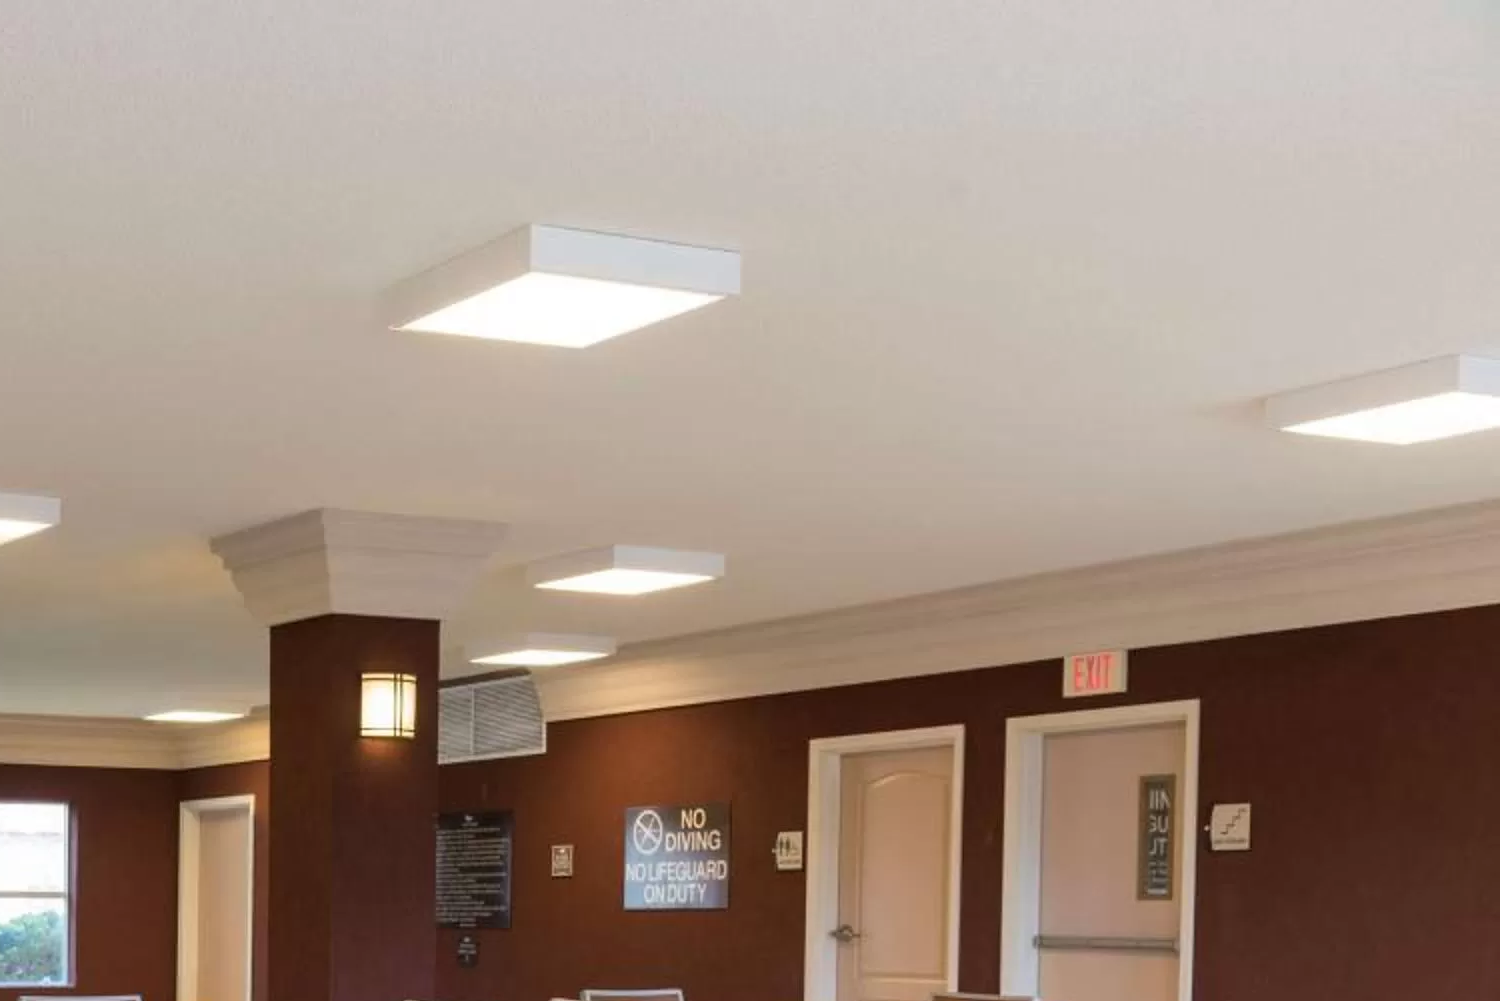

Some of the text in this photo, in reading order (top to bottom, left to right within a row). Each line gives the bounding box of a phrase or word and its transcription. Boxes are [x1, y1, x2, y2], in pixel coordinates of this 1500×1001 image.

[1073, 653, 1113, 692] EXIT
[681, 808, 707, 829] NO
[665, 830, 722, 852] DIVING
[626, 859, 728, 881] NO LIFEGUARD
[643, 883, 708, 905] ON DUTY
